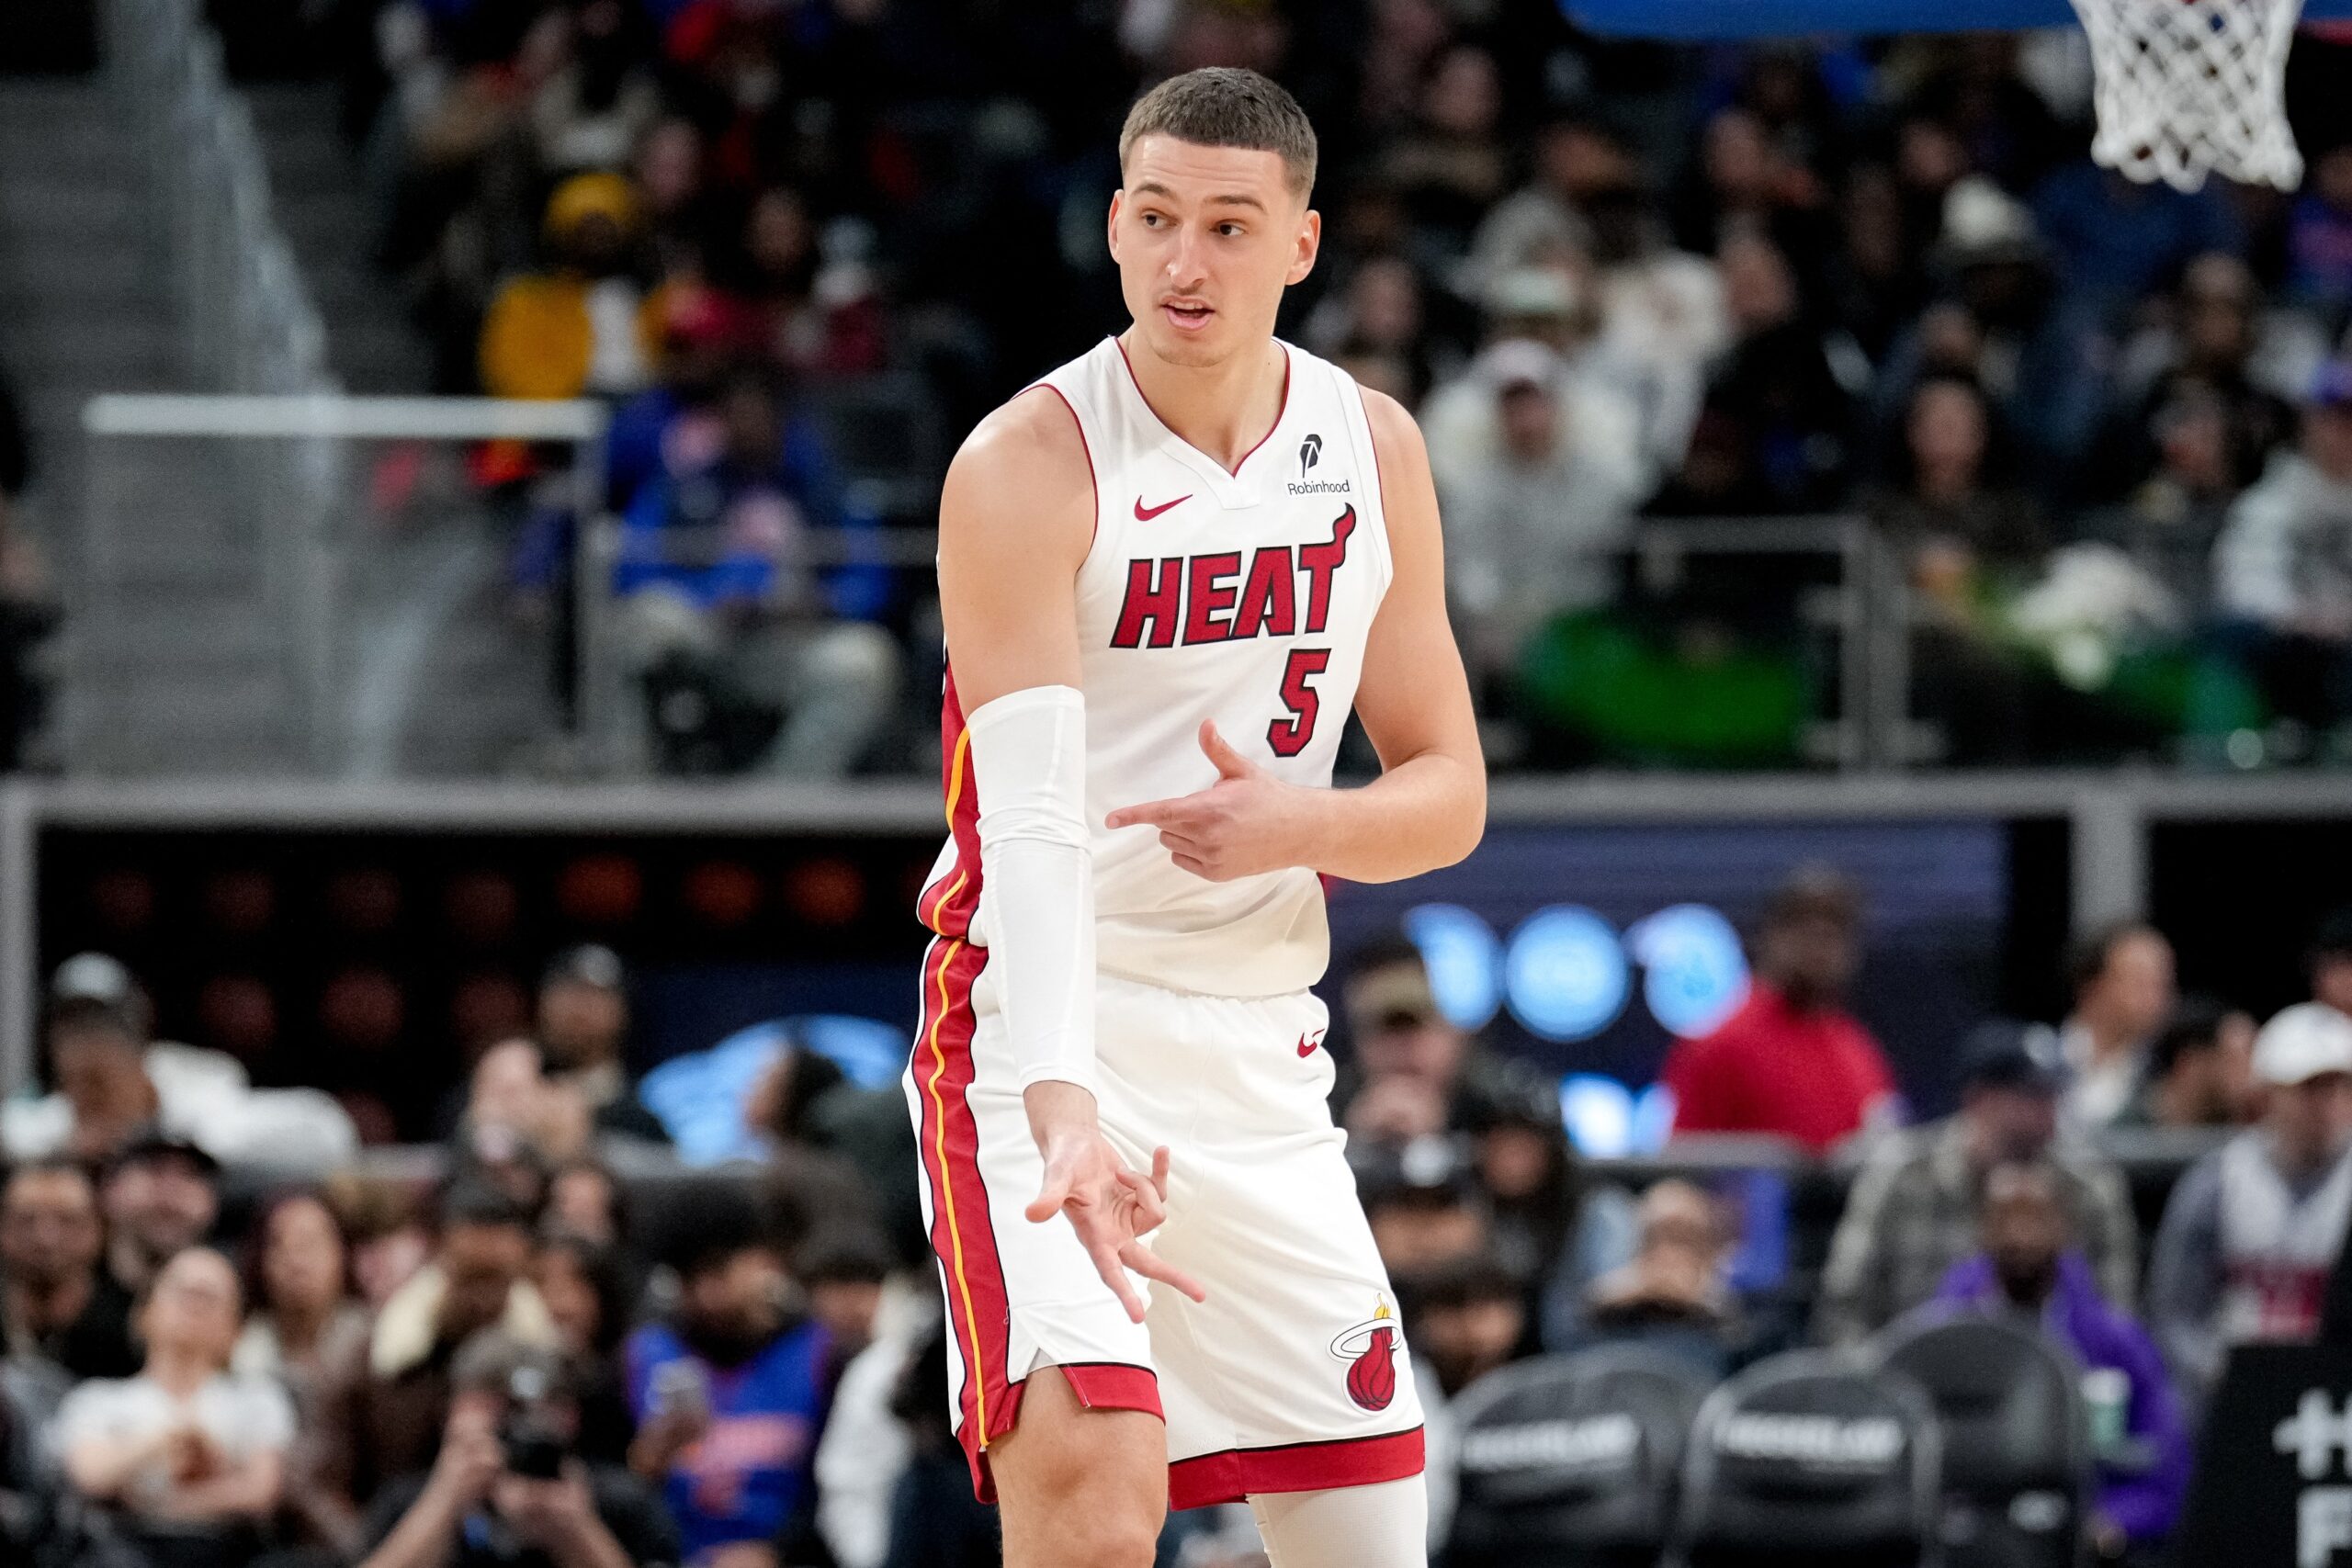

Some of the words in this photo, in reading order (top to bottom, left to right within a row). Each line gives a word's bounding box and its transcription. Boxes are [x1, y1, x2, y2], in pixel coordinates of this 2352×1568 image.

[1287, 479, 1351, 495] Robinhood
[1109, 502, 1356, 649] HEAT
[1266, 648, 1331, 758] 5
